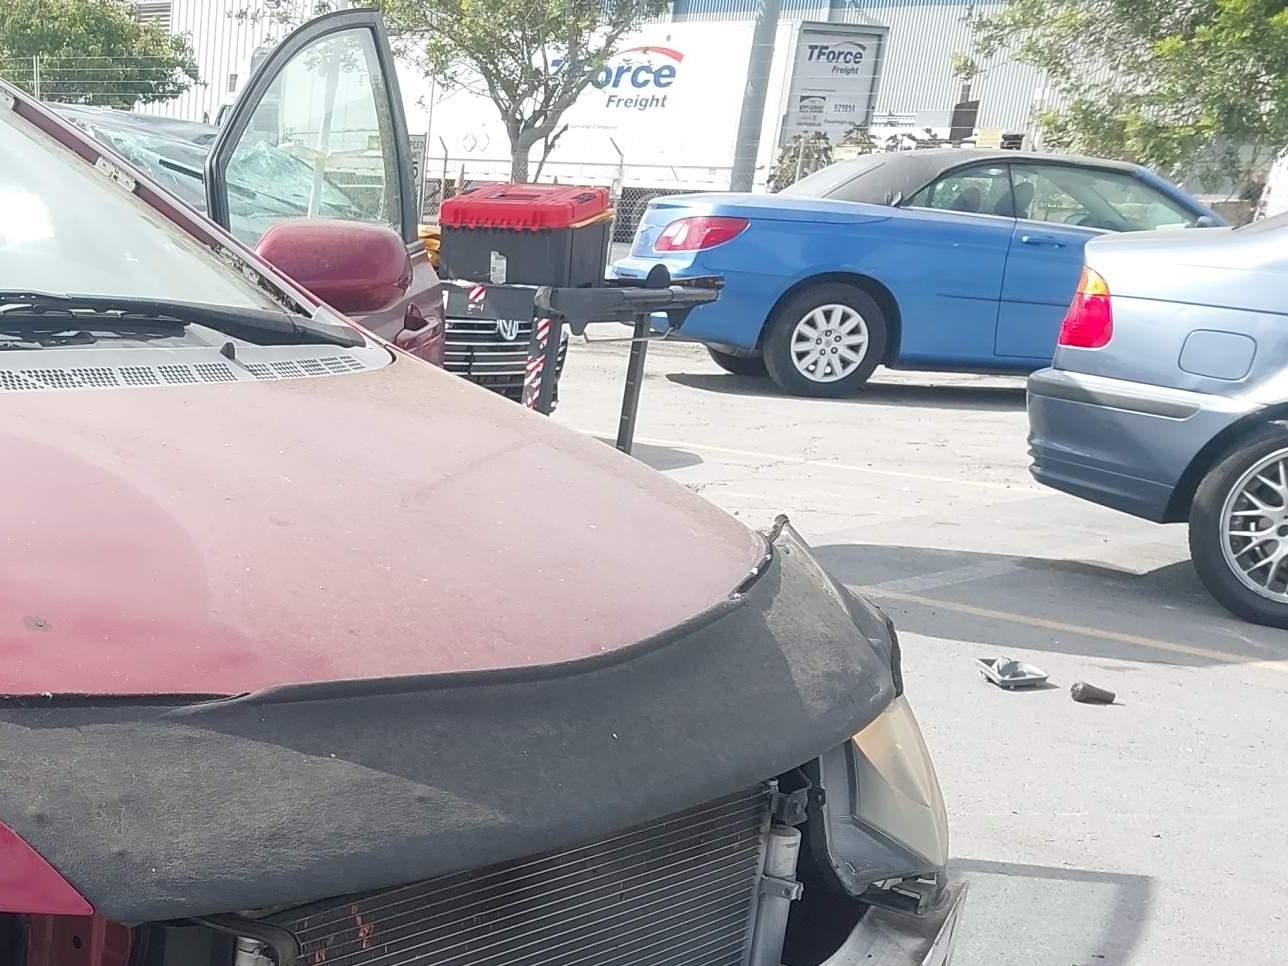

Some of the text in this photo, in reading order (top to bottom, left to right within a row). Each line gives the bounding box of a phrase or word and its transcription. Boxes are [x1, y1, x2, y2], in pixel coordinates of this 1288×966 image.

[807, 44, 863, 64] TForce
[832, 65, 859, 75] Freight
[606, 94, 668, 111] Freight
